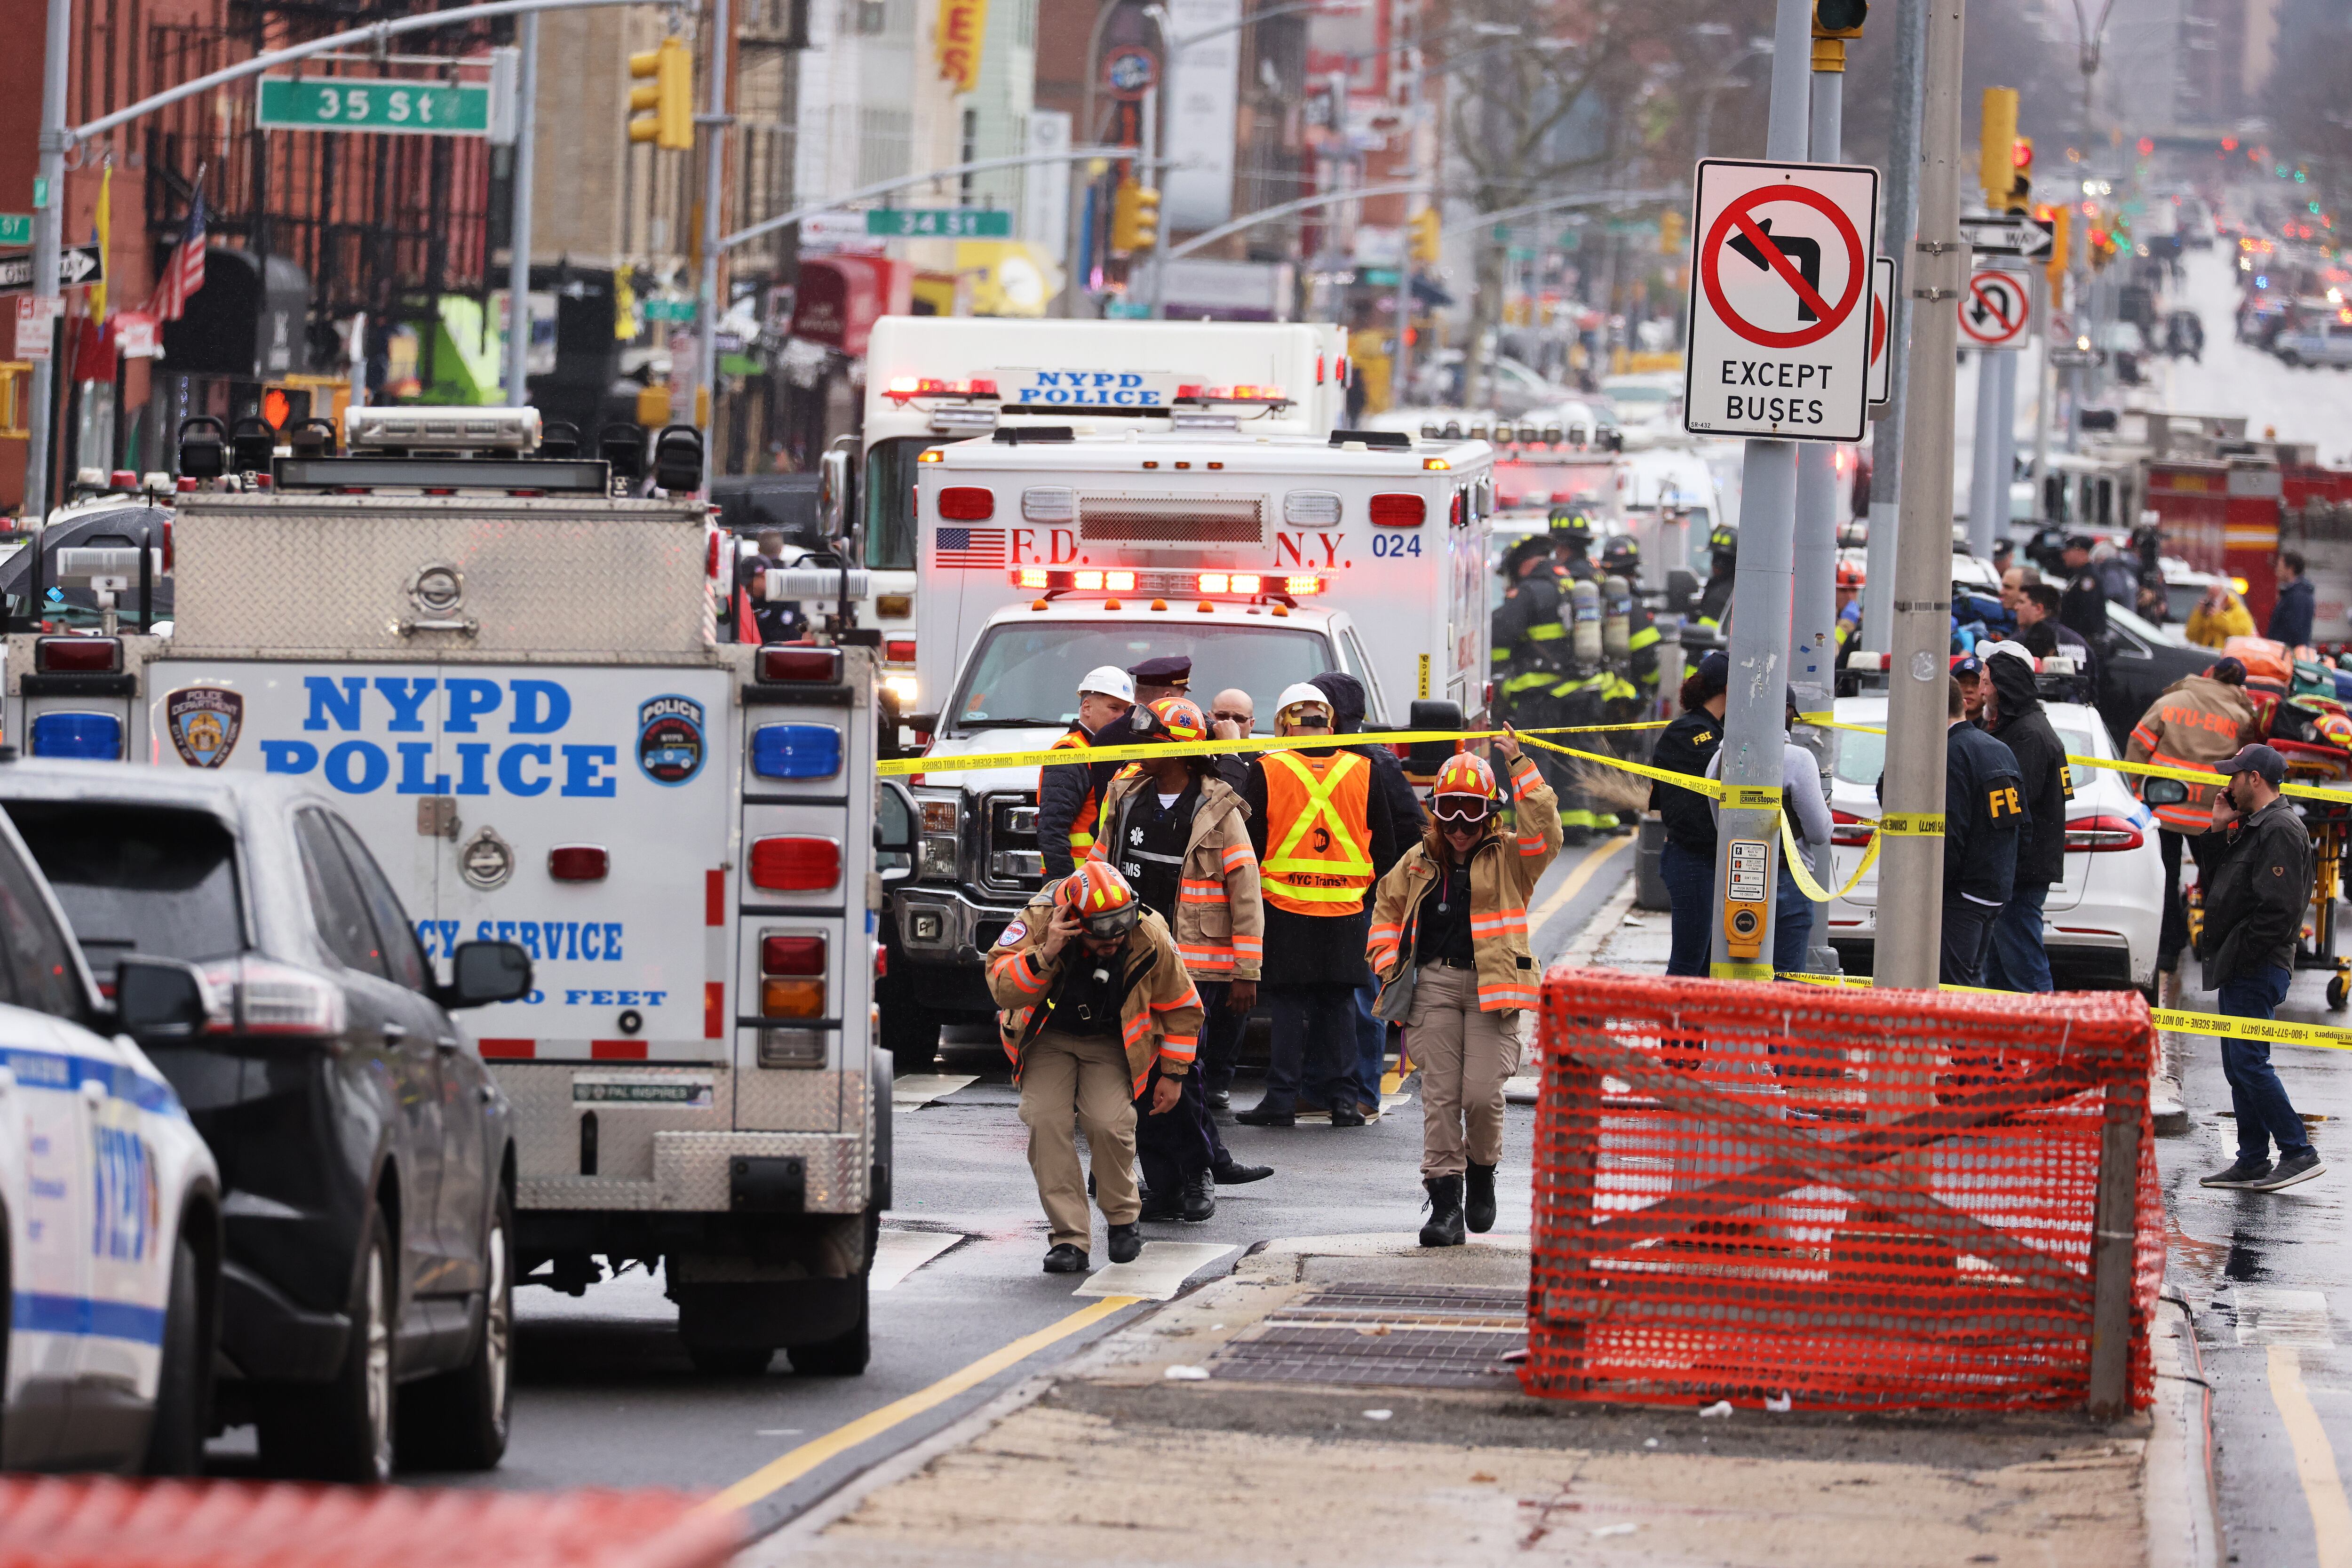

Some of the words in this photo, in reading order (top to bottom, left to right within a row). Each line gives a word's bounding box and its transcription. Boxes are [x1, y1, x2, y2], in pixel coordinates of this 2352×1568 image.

[942, 0, 977, 84] ES
[317, 89, 370, 121] 35
[388, 91, 433, 122] St
[1037, 372, 1144, 388] NYPD
[1722, 360, 1833, 389] EXCEPT
[1019, 389, 1161, 406] POLICE
[1727, 397, 1823, 424] BUSES
[1010, 529, 1089, 565] F.D.
[1274, 532, 1352, 568] N.Y.
[1372, 534, 1422, 558] 024
[185, 690, 224, 701] POLICE
[303, 677, 571, 734] NYPD
[643, 699, 701, 724] POLICE
[2161, 705, 2239, 740] NYU-EMS
[1692, 731, 1712, 746] FBI
[260, 740, 617, 797] POLICE
[1741, 795, 1780, 805] CRIMEstoppers
[1888, 820, 1907, 832] CRIME
[1919, 820, 1937, 833] (8477)
[1120, 861, 1141, 878] EMS
[1080, 873, 1089, 889] EMT
[1288, 874, 1311, 886] NYC
[1315, 876, 1348, 887] Transit
[565, 989, 667, 1006] FEET
[2161, 1015, 2174, 1025] NOT
[2175, 1017, 2184, 1027] DO
[2191, 1018, 2210, 1030] SCENE
[2211, 1020, 2231, 1032] CRIME
[2241, 1023, 2260, 1036] (8477)
[2261, 1025, 2309, 1040] 1-800-577-TIPS
